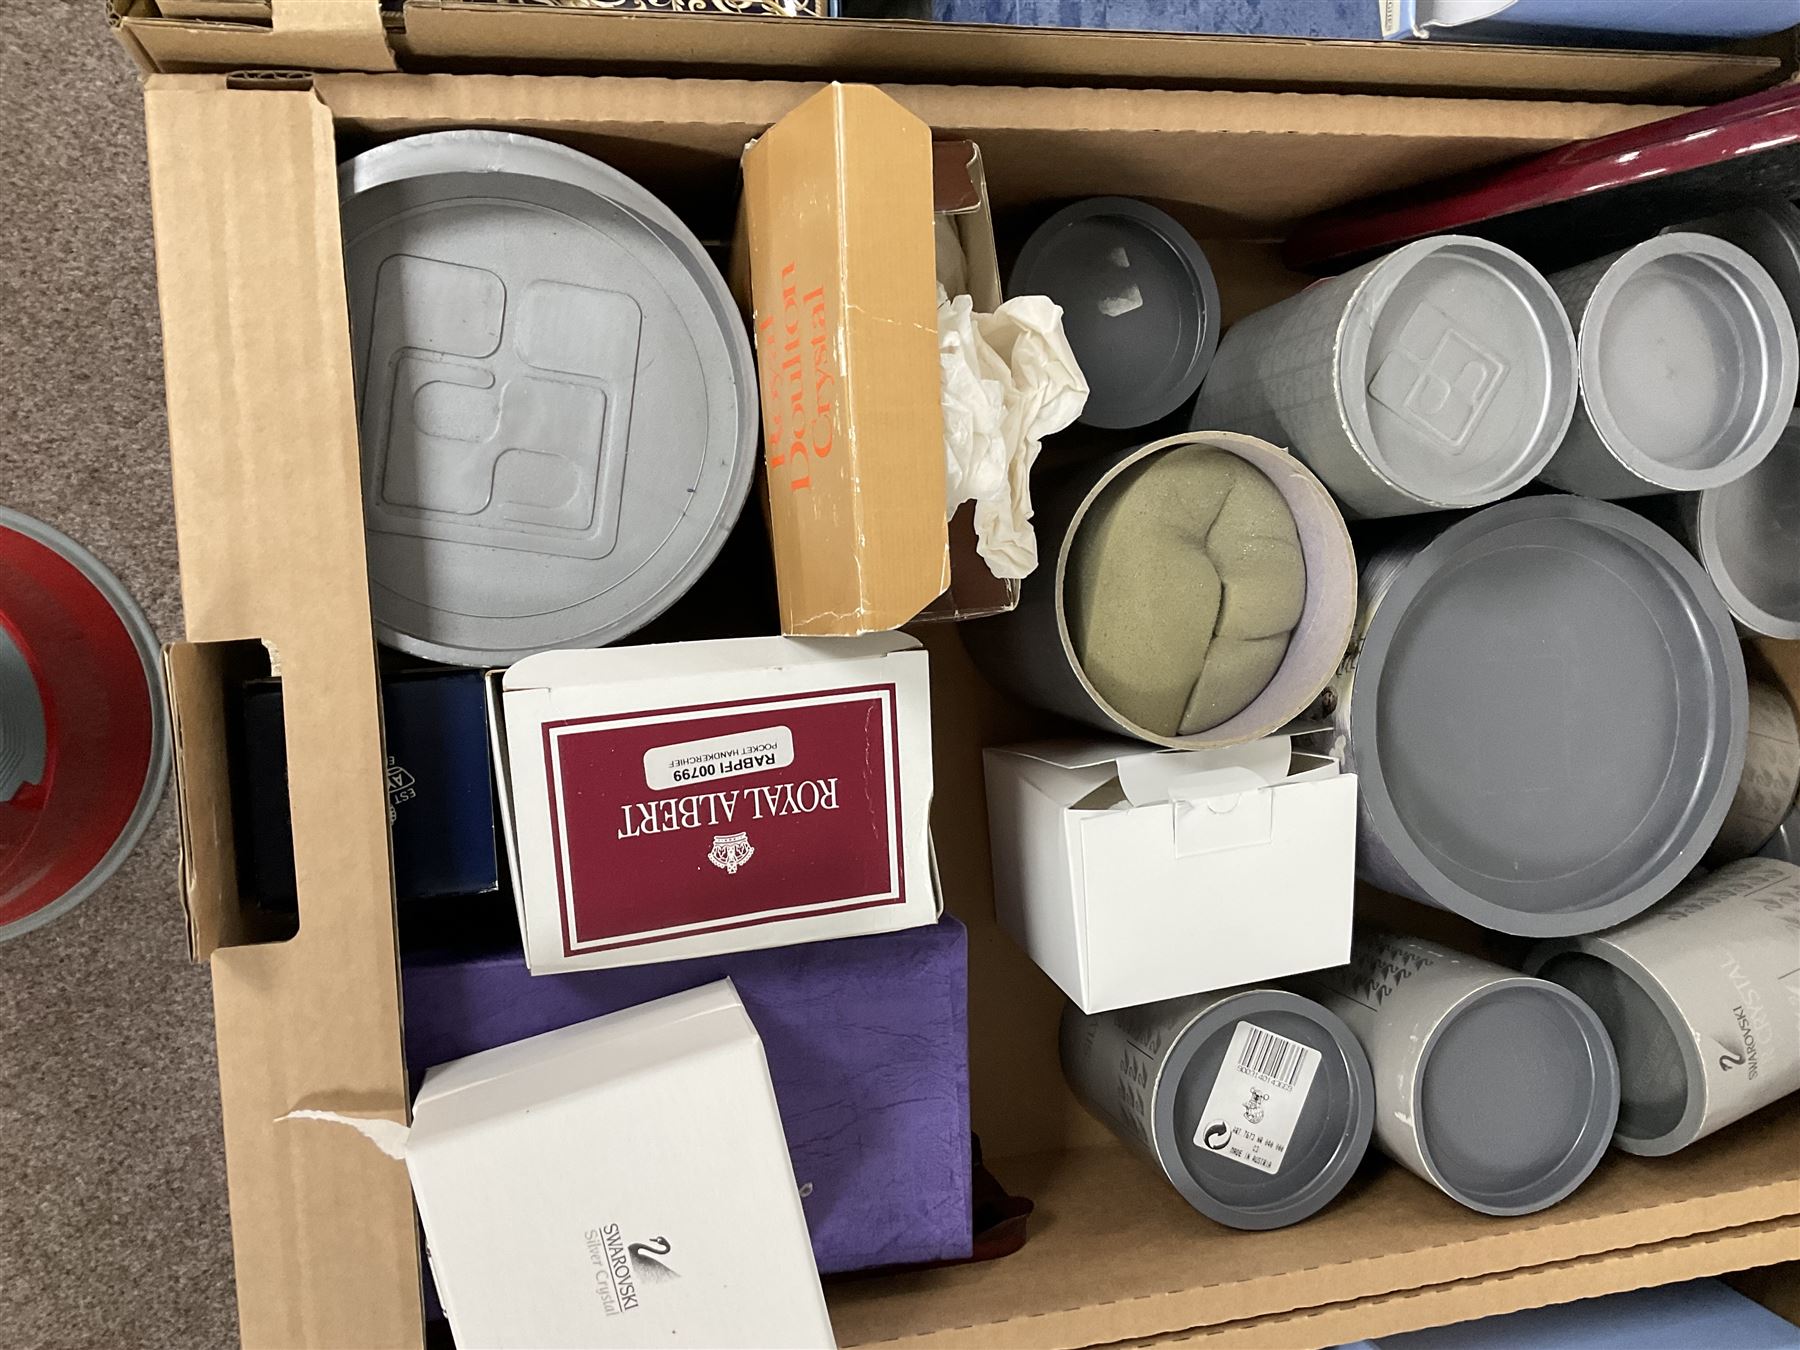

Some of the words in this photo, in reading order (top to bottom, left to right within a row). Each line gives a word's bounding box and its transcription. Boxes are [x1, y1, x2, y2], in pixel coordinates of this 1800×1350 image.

[760, 315, 785, 469] Royal
[782, 262, 811, 491] Doulton
[803, 284, 835, 458] Crystal
[668, 749, 740, 768] HANDKERCHIEF
[673, 764, 715, 782] 00799
[720, 753, 776, 774] RABPFI
[741, 742, 777, 755] POCKET
[617, 790, 740, 839] ALBERT
[744, 778, 839, 819] ROYAL
[1720, 952, 1773, 1045] CRYSTAL
[1733, 1005, 1758, 1081] SWAROVSKI
[1230, 1147, 1243, 1158] MADE
[1245, 1150, 1251, 1160] IN
[1252, 1153, 1273, 1168] AUSTRIA
[585, 1229, 603, 1266] Silver
[595, 1270, 620, 1317] Crystal
[603, 1223, 639, 1310] SWAROVSKI
